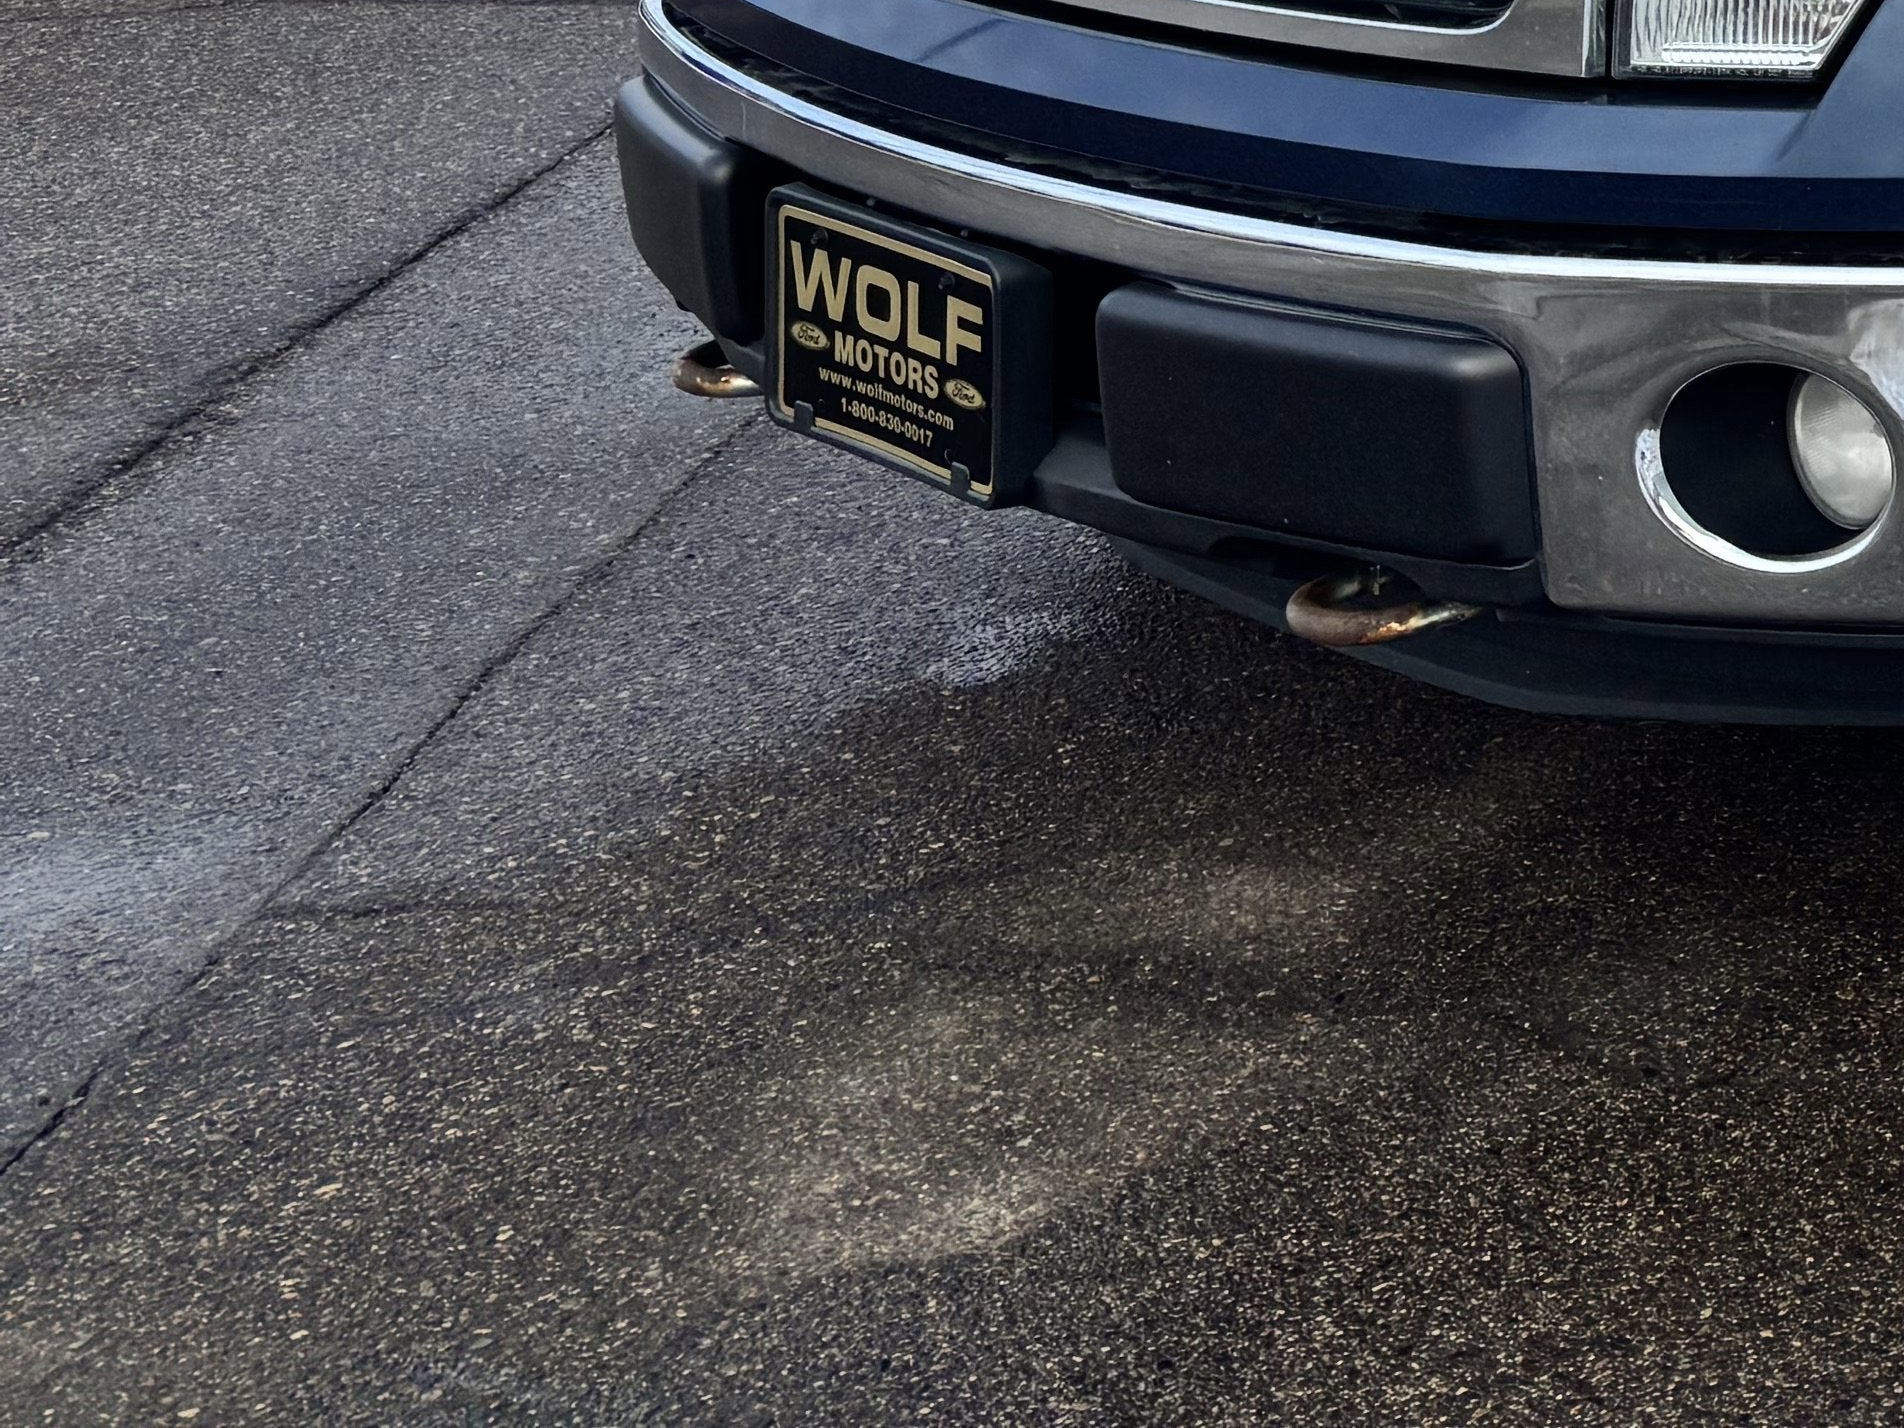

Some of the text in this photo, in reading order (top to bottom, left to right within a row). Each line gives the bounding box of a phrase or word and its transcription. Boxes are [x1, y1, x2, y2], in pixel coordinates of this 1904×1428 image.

[790, 239, 984, 366] WOLF
[818, 366, 955, 432] www.wolfmotors.com
[834, 330, 940, 400] MOTORS
